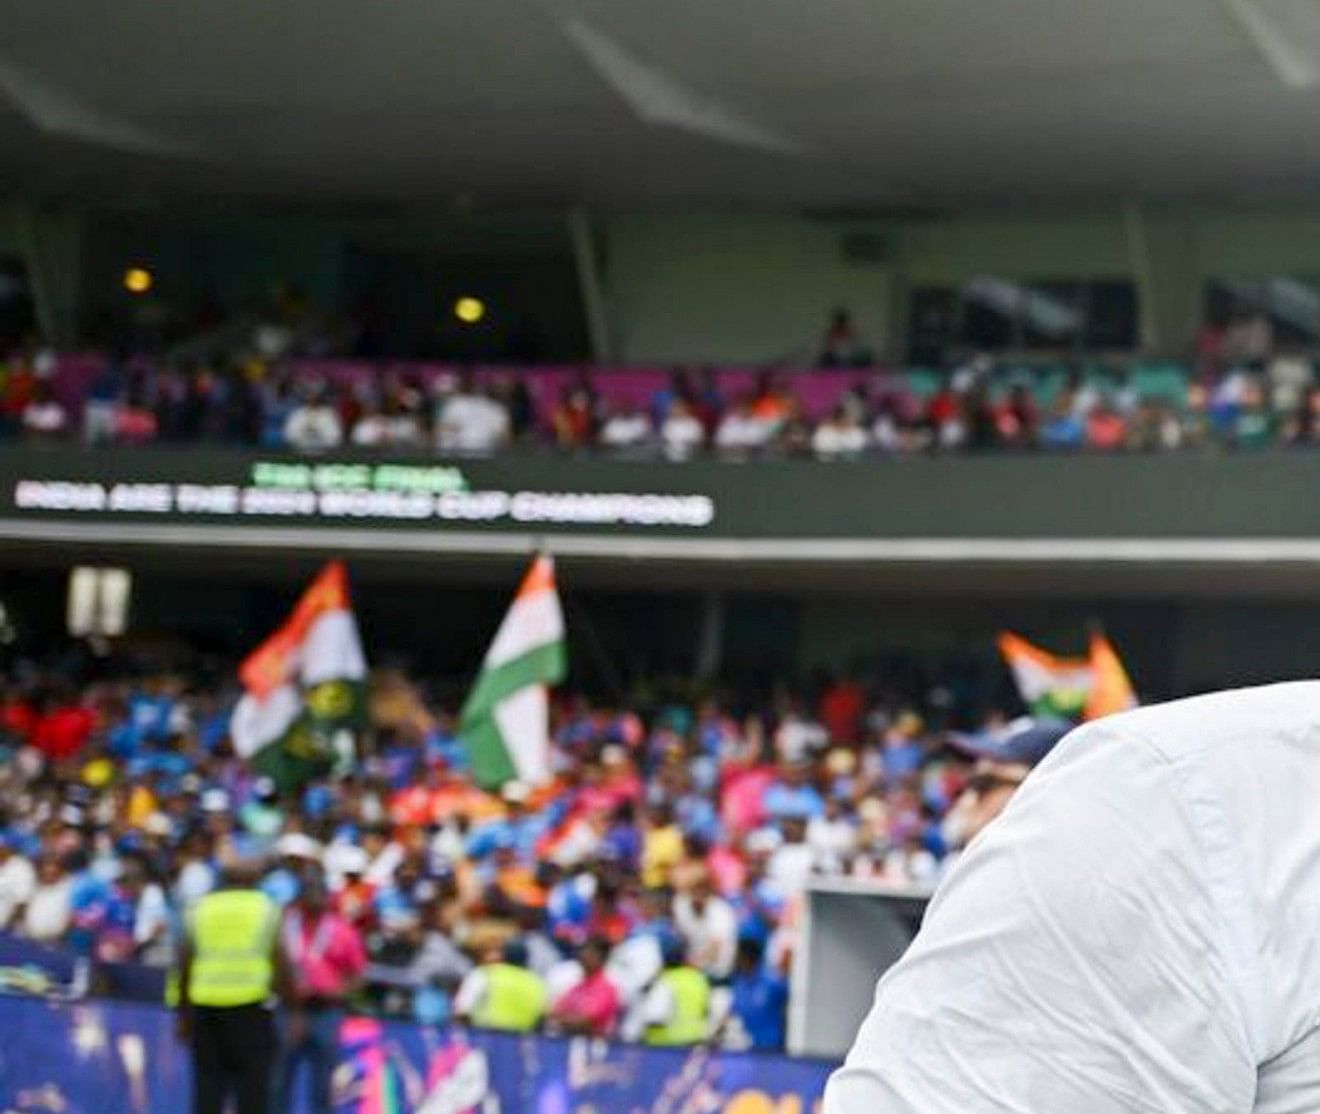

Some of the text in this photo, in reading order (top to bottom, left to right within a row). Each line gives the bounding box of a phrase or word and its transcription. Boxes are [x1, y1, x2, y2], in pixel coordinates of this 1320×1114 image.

[319, 488, 434, 519] WORLD
[436, 491, 511, 520] CUP
[511, 492, 714, 526] CHAMPIONS
